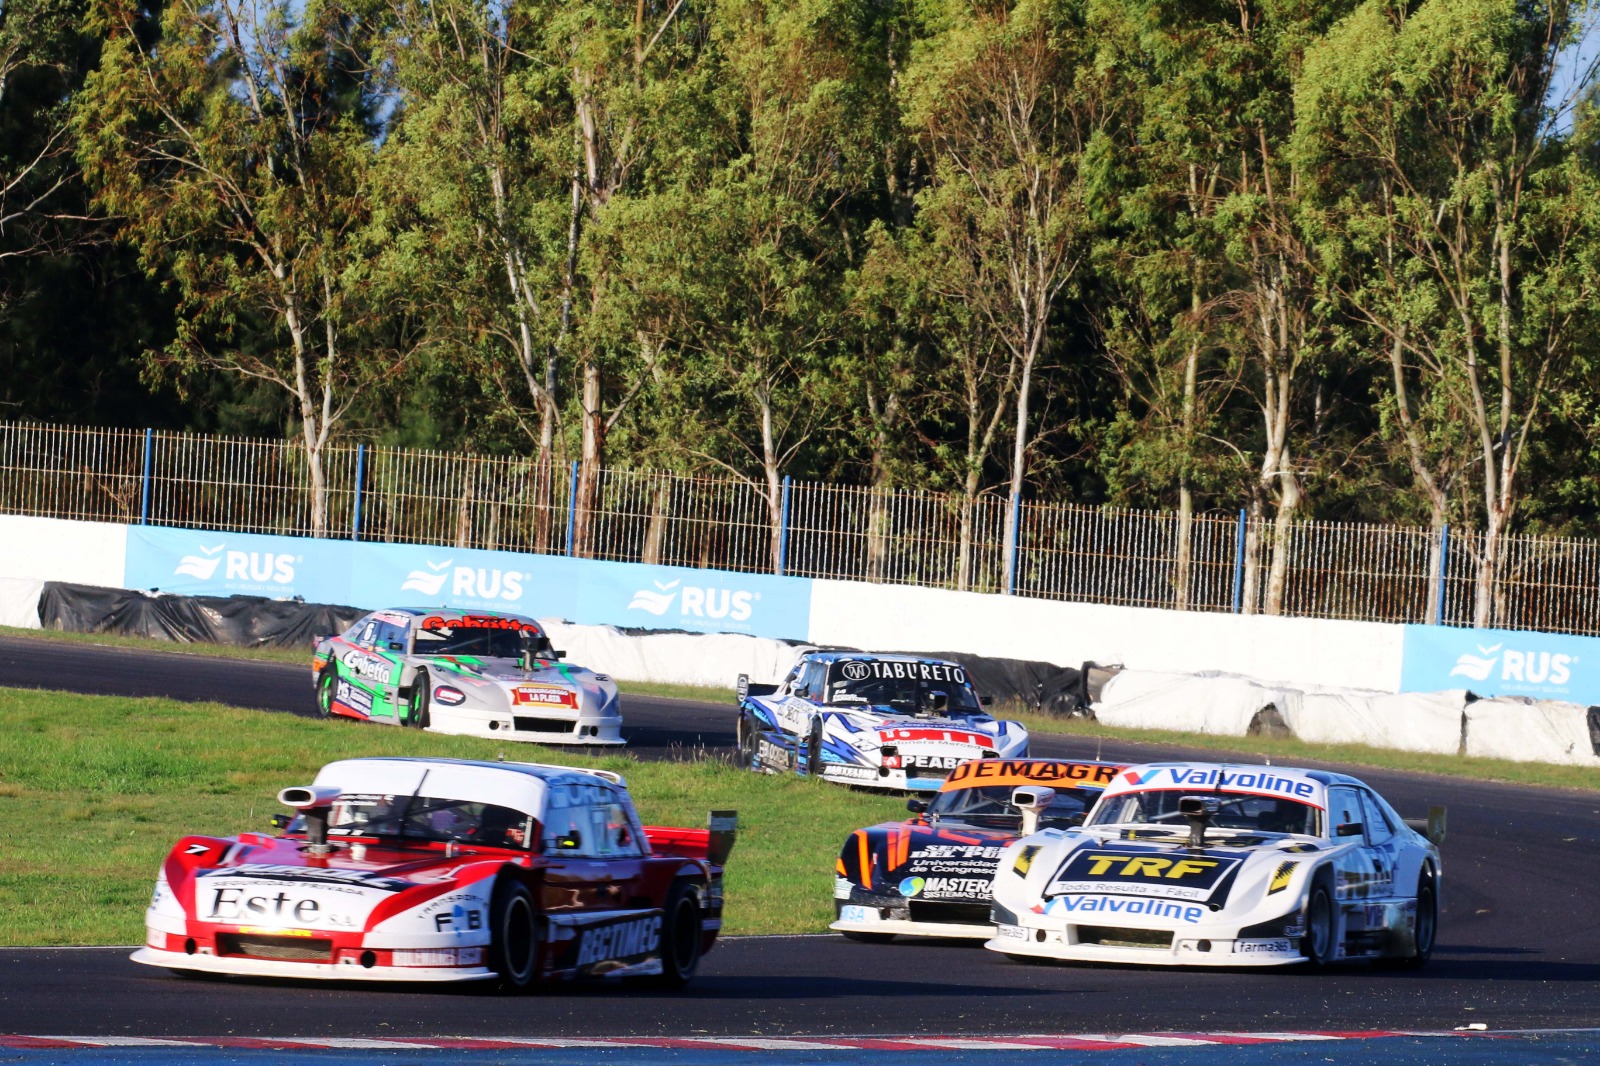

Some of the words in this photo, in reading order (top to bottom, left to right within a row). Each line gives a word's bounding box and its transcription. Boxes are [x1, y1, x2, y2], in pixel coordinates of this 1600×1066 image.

[363, 622, 375, 641] 6
[871, 662, 965, 684] TABURETO
[1170, 769, 1314, 798] Valvoline
[1087, 855, 1219, 879] TRF
[299, 882, 365, 896] PRIVADA
[1060, 883, 1090, 891] Todo
[1095, 884, 1147, 893] Resulta
[207, 888, 320, 923] Este
[1063, 896, 1203, 924] Valvoline
[1240, 941, 1289, 953] farma365
